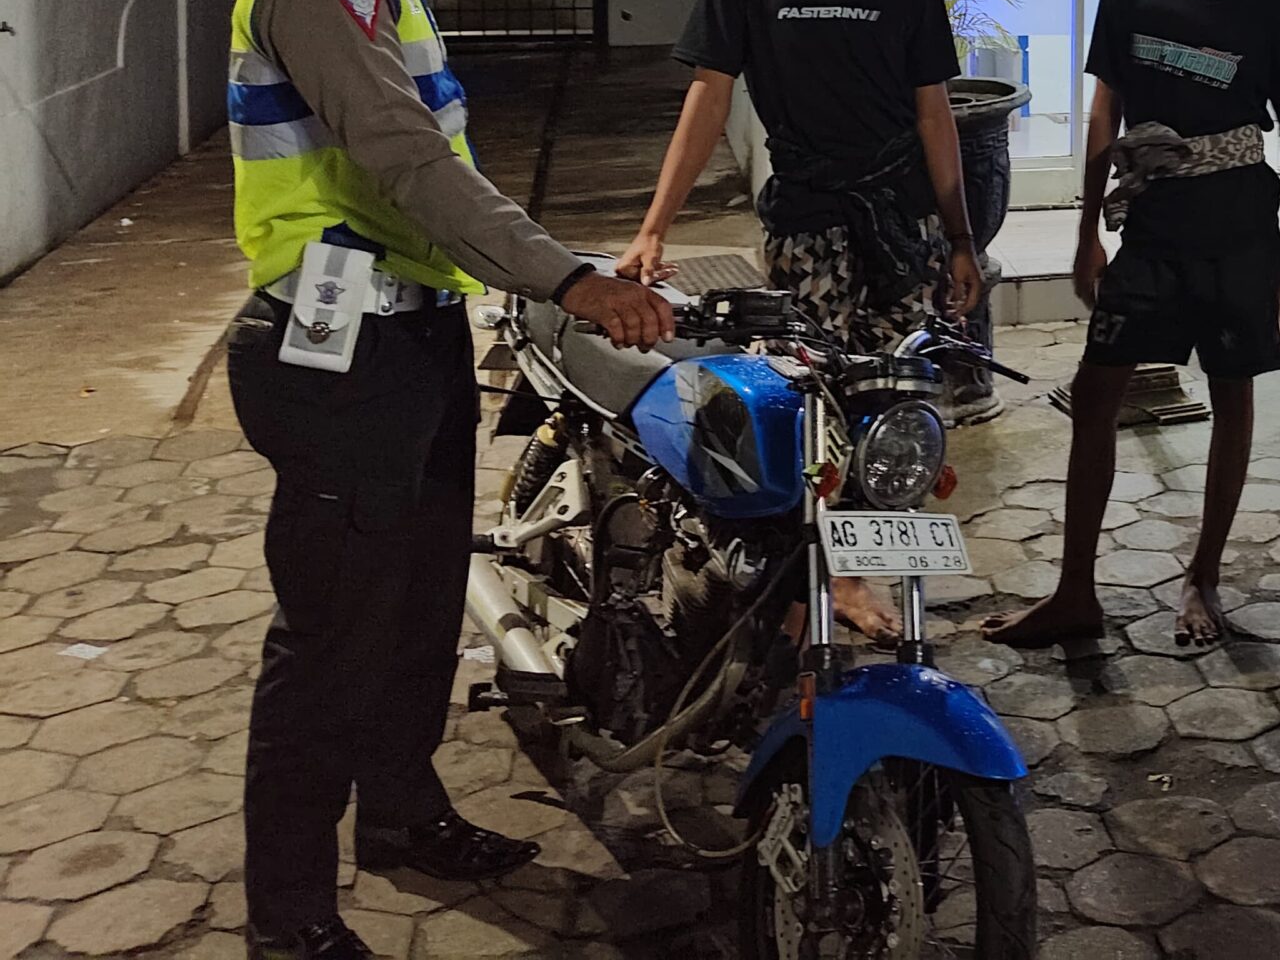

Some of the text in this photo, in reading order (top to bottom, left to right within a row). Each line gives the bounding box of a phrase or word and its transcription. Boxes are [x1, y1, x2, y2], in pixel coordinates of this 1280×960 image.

[830, 519, 955, 548] AG 3781 CT
